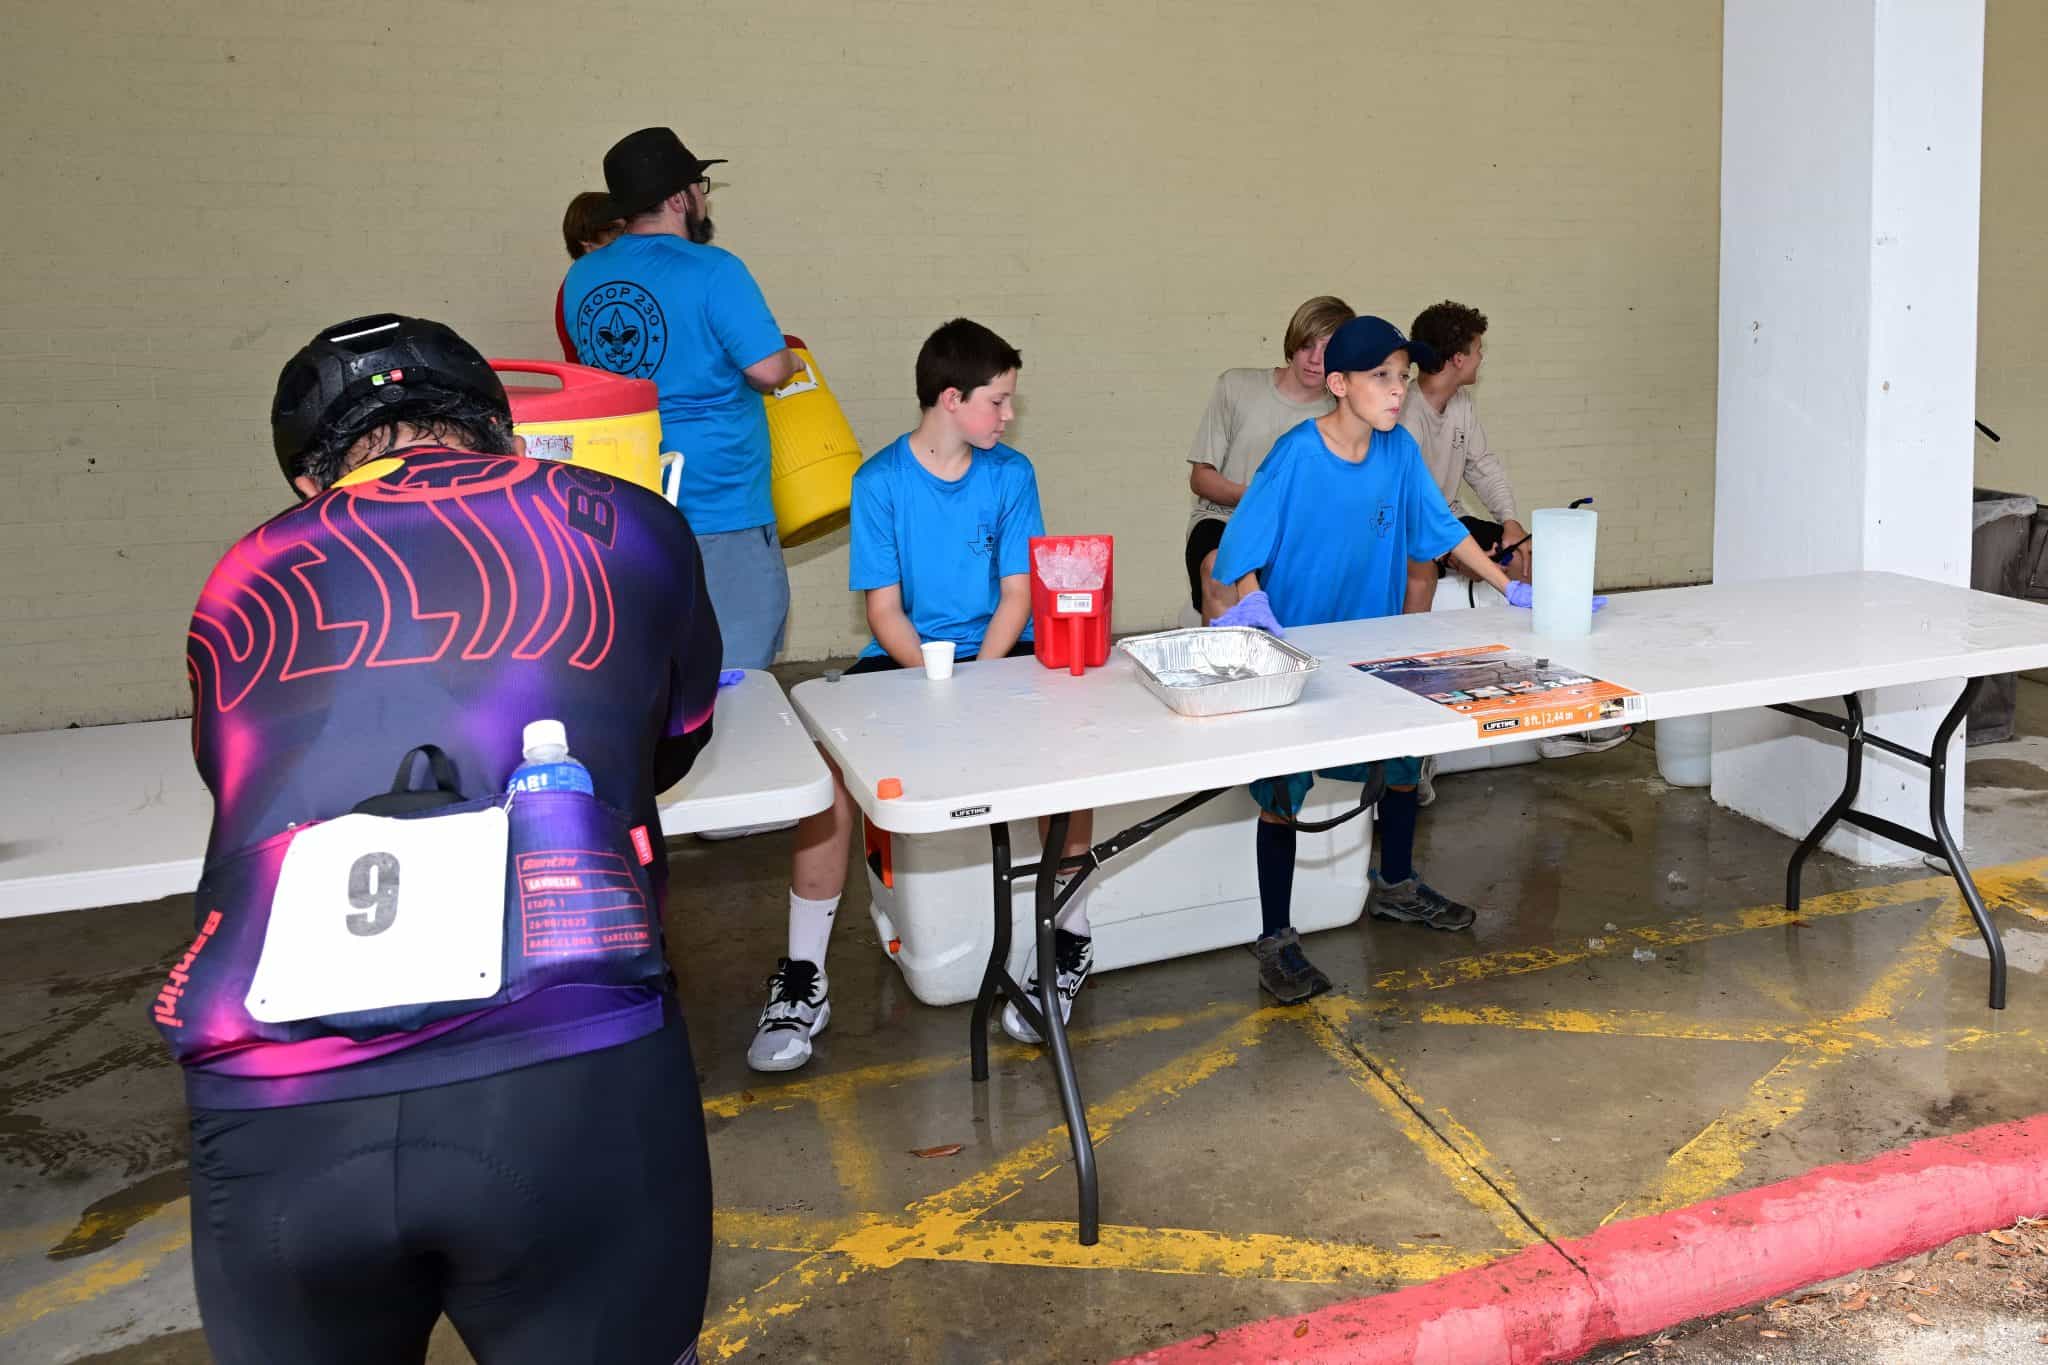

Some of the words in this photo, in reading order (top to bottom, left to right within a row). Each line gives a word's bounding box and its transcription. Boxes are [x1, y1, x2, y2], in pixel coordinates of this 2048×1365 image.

[580, 287, 631, 328] TROOP
[634, 293, 660, 327] 230
[1485, 719, 1517, 730] LIFETIME
[954, 806, 987, 817] LIFETIME
[345, 851, 401, 937] 9
